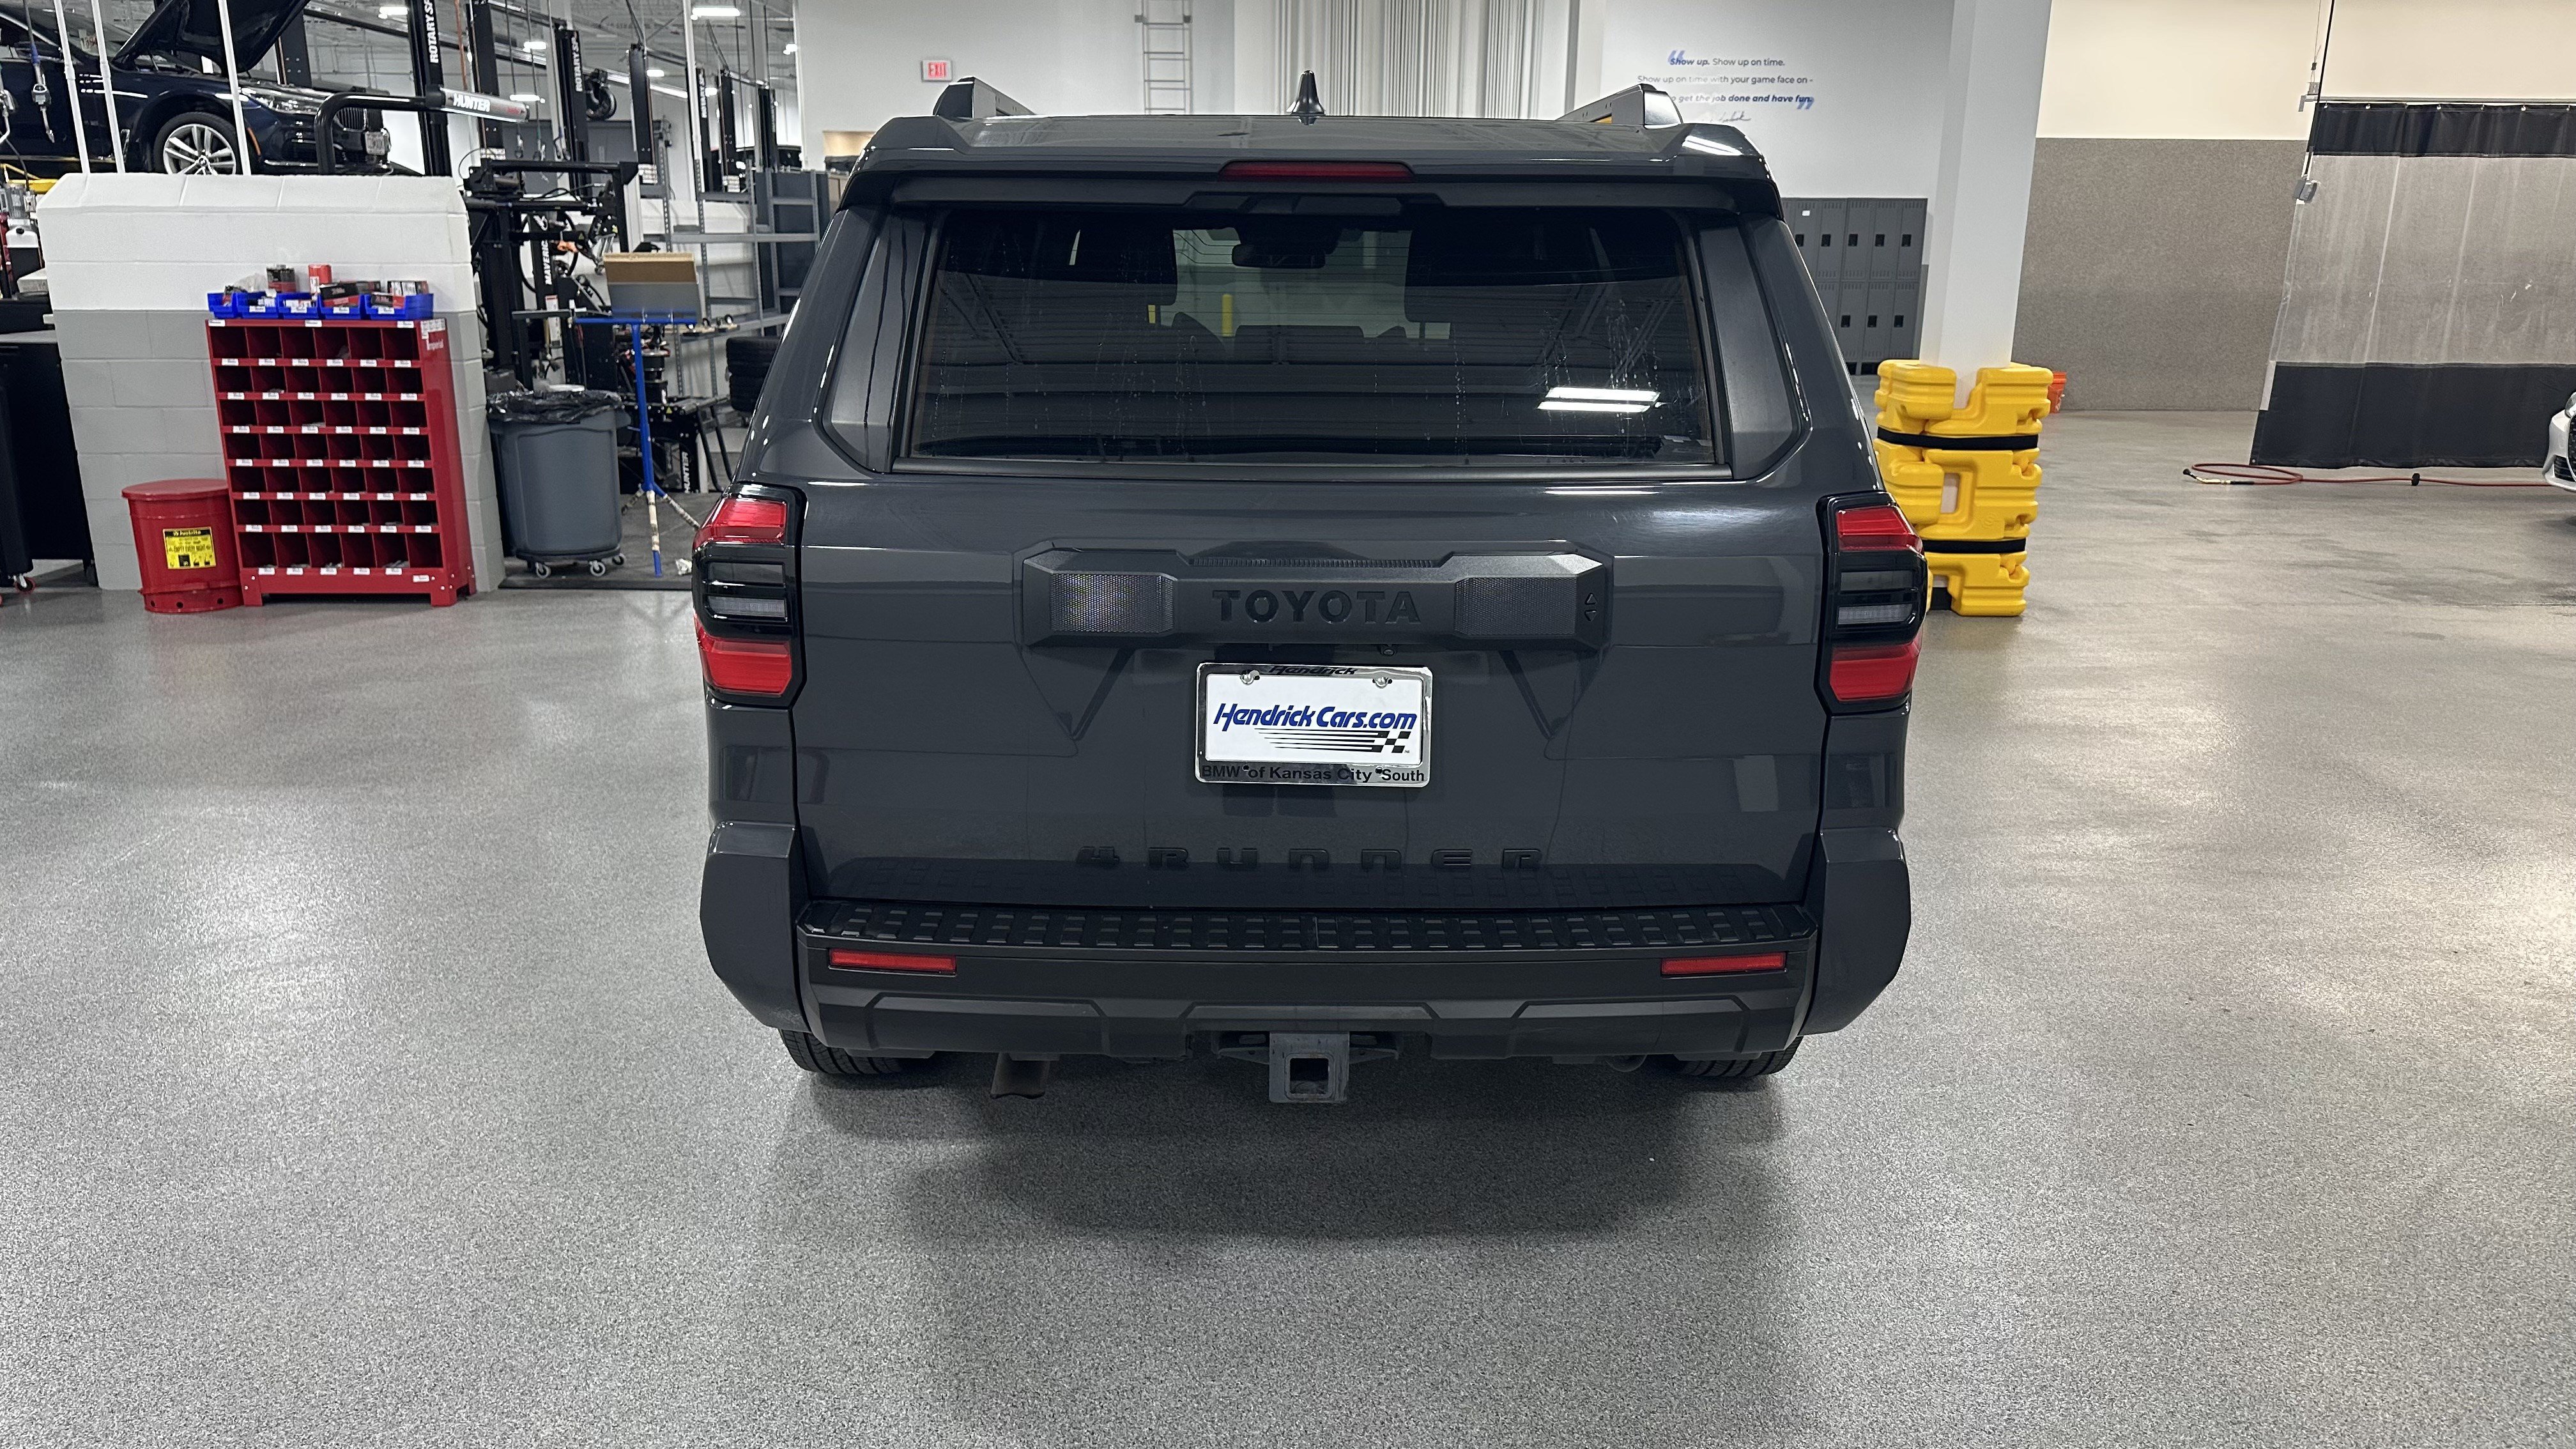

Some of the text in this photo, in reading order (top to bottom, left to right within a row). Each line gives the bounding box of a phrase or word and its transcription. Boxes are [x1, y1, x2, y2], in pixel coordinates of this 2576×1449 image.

[425, 14, 439, 63] ROTARY
[1669, 57, 1695, 66] Show
[1730, 77, 1749, 85] your
[1751, 77, 1775, 85] game
[1777, 75, 1795, 84] face
[453, 93, 491, 112] HUNTER
[1712, 95, 1726, 103] job
[541, 240, 552, 285] MAVERIC
[1213, 589, 1422, 624] TOYOTA
[1269, 666, 1358, 676] Hendrick
[1202, 765, 1425, 783] BMW of Kansas City South
